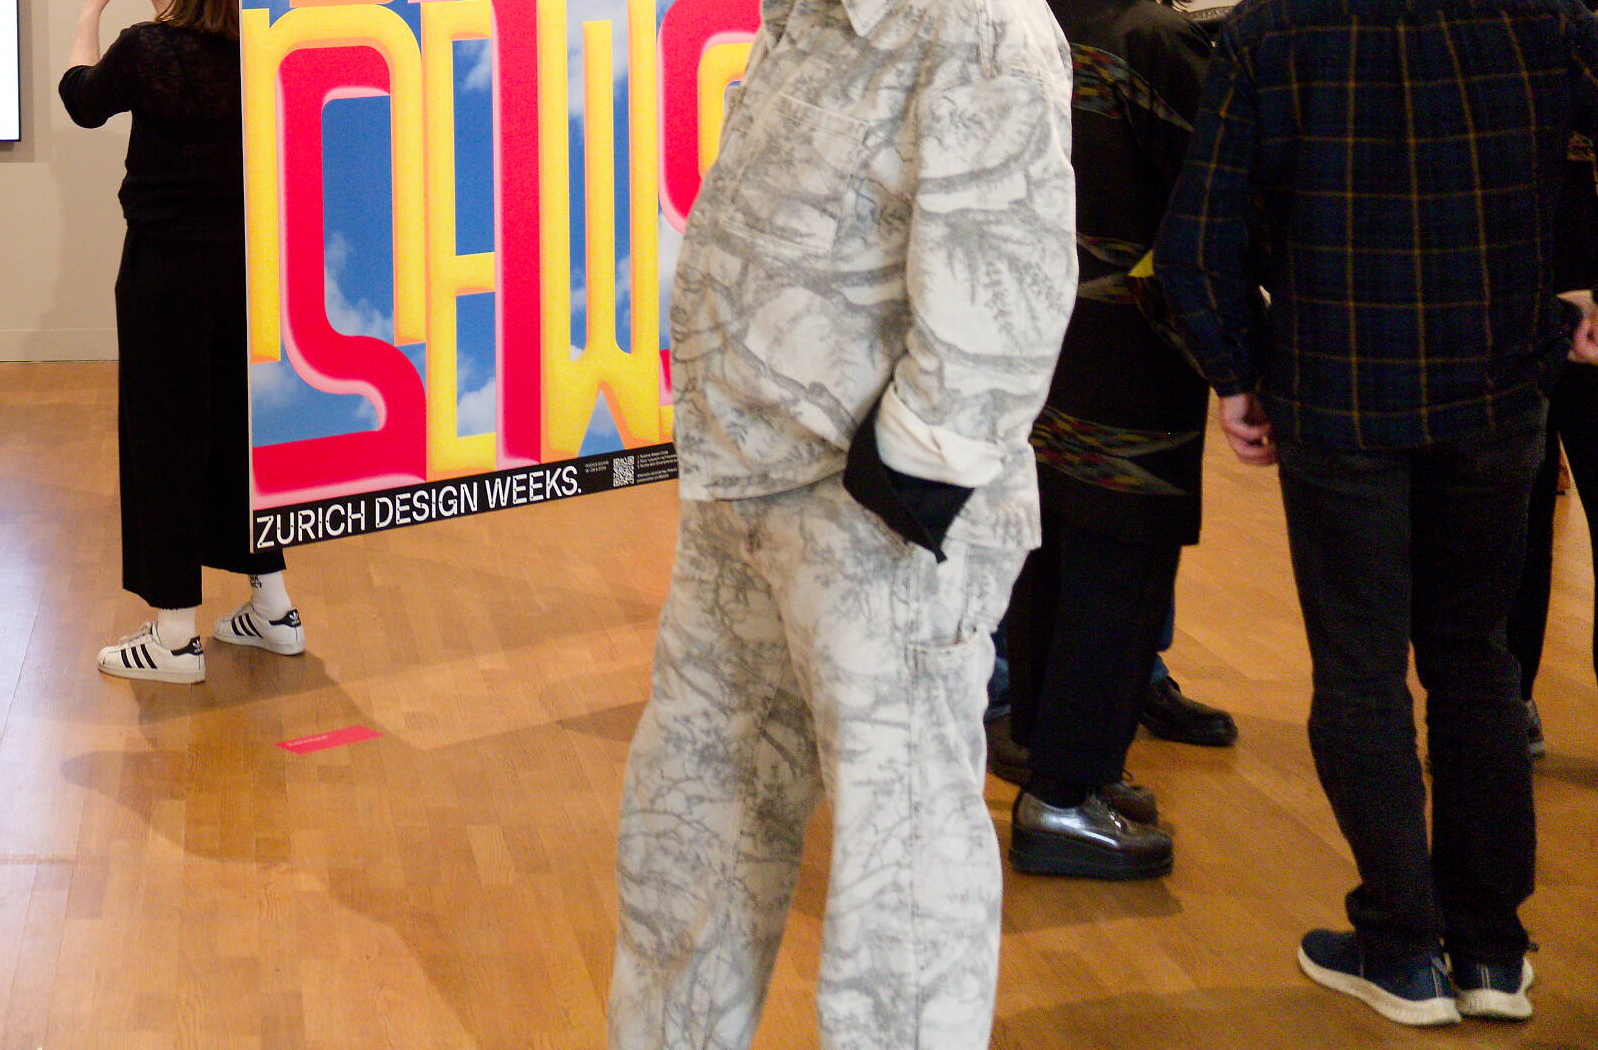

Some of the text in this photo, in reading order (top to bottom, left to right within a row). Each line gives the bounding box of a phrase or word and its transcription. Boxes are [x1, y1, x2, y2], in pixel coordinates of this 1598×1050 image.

[256, 500, 366, 549] ZURICH
[375, 481, 478, 529] DESIGN
[484, 464, 582, 509] WEEKS.
